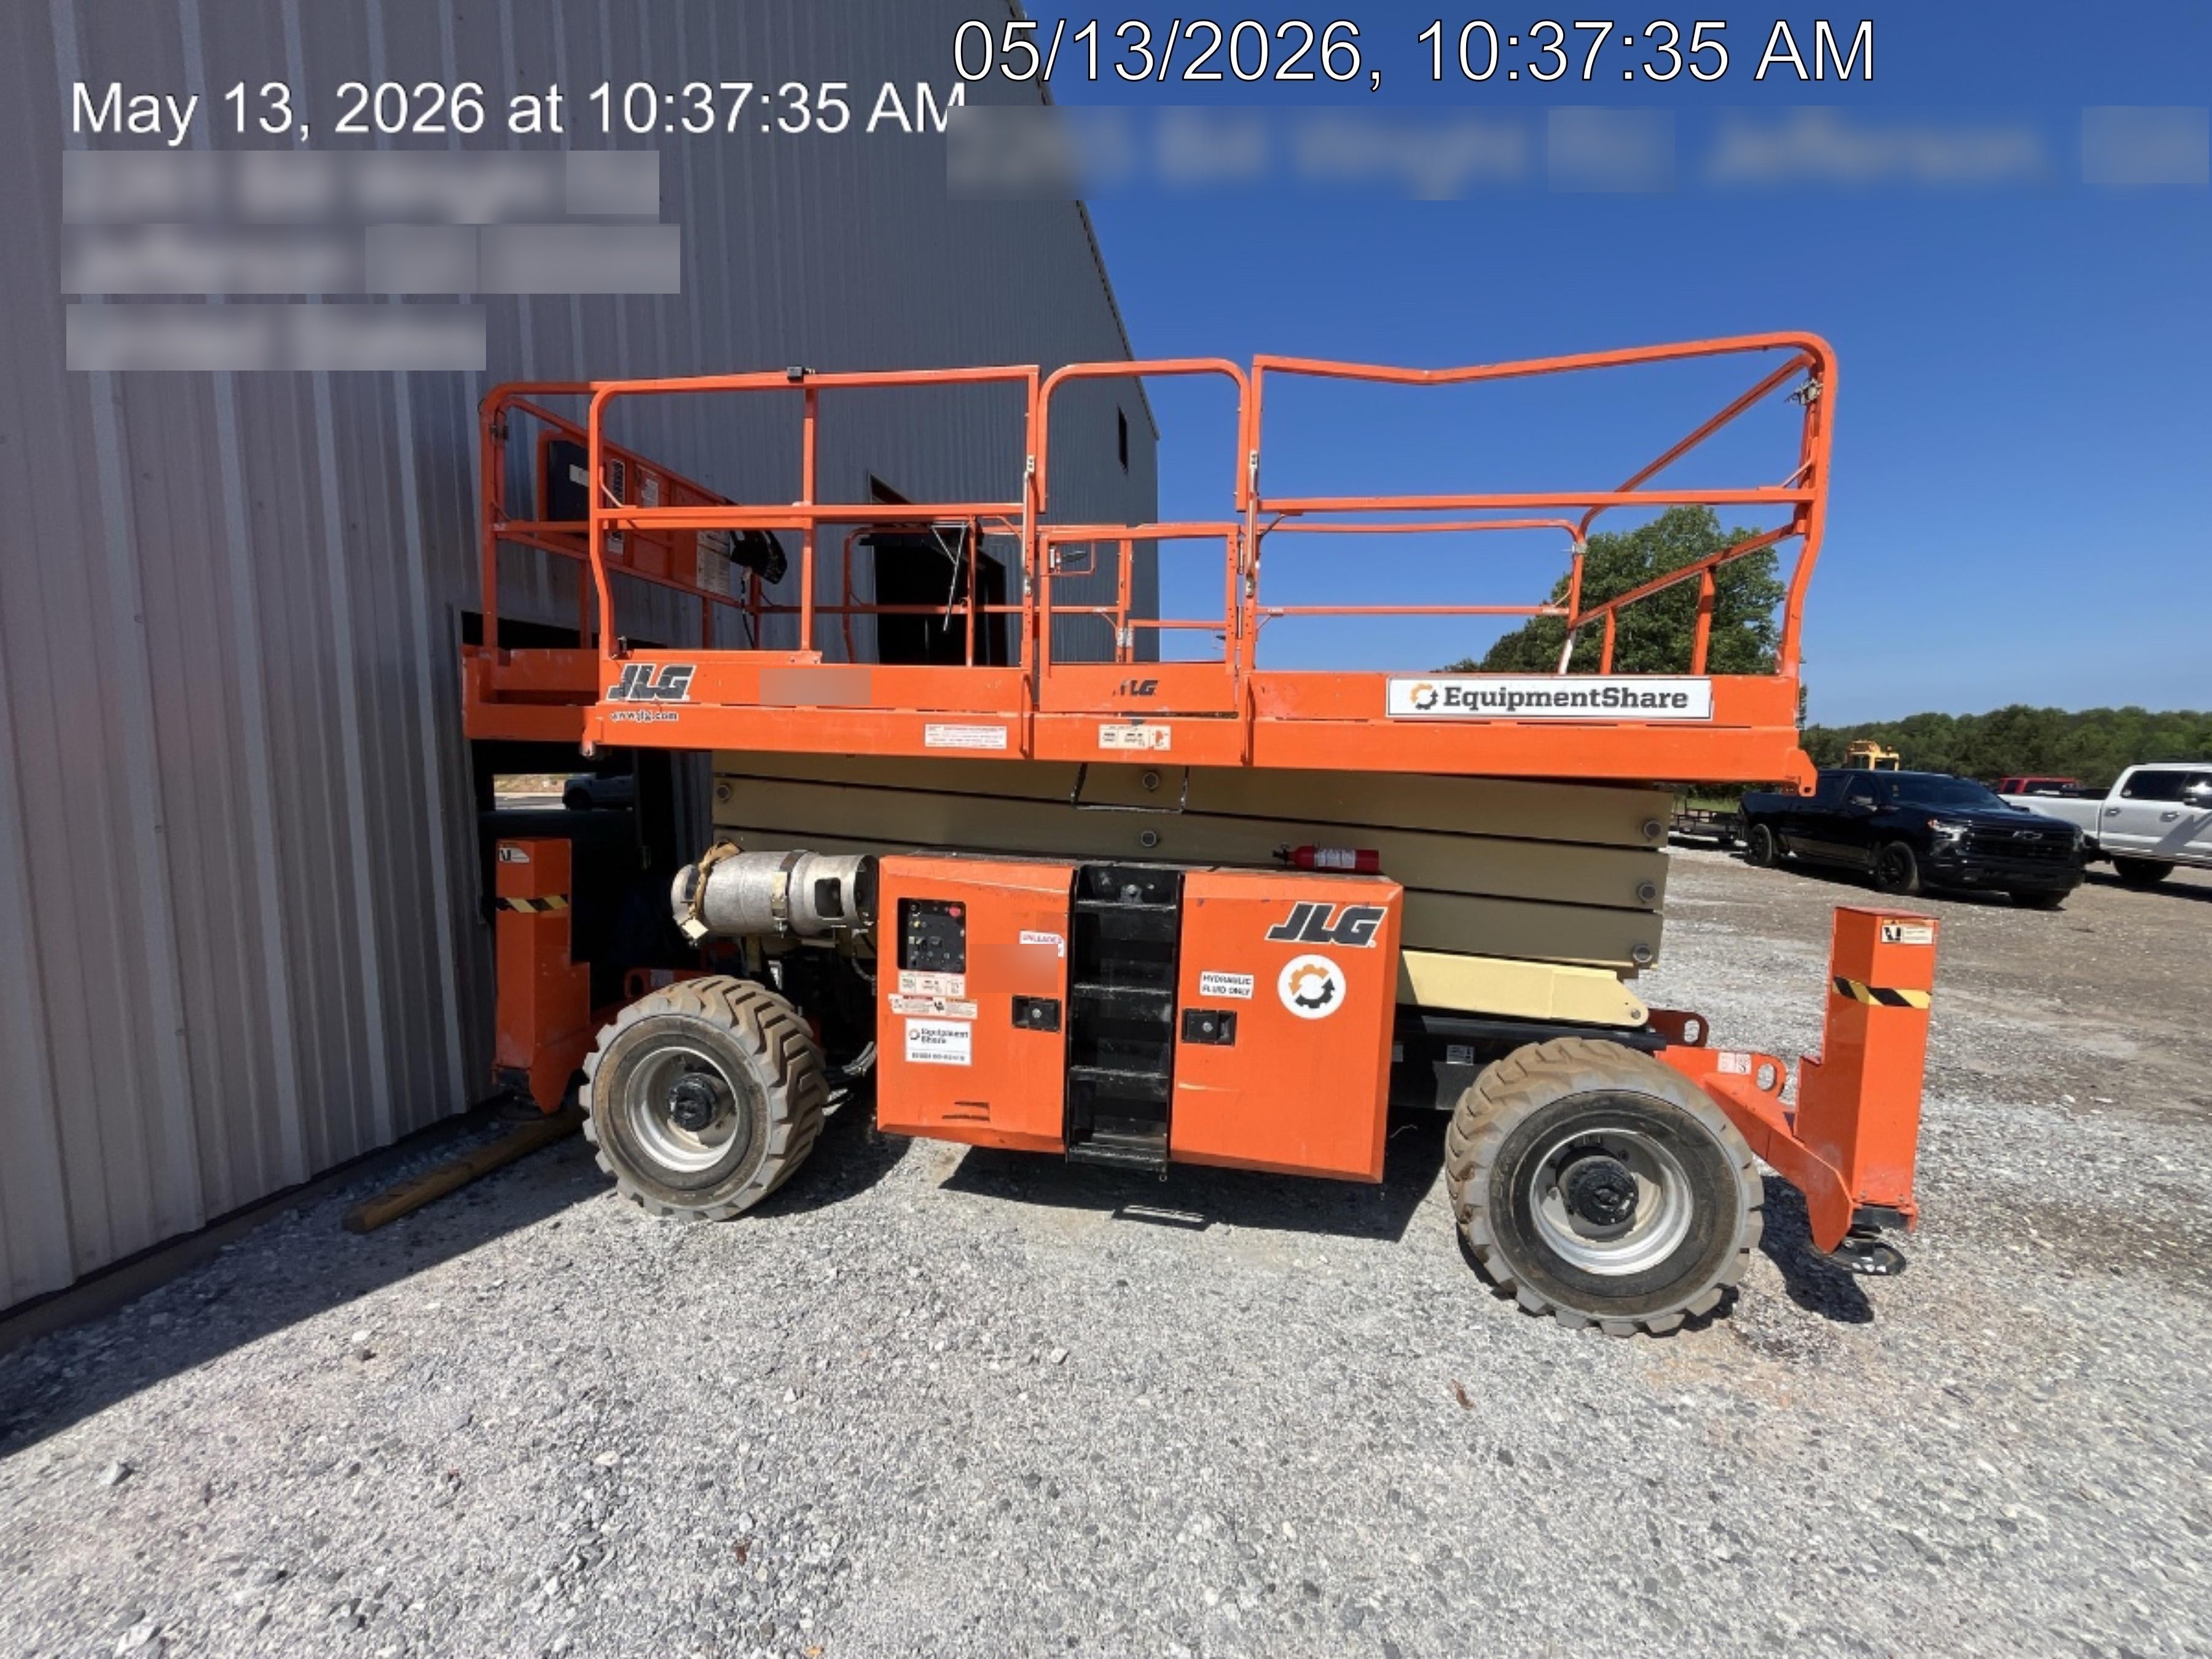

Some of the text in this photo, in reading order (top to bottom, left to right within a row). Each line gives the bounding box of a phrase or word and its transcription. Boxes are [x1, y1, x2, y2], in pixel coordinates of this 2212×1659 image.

[606, 664, 697, 702] JLG
[1443, 686, 1688, 712] EquipmentShare
[1264, 901, 1388, 948] JLG
